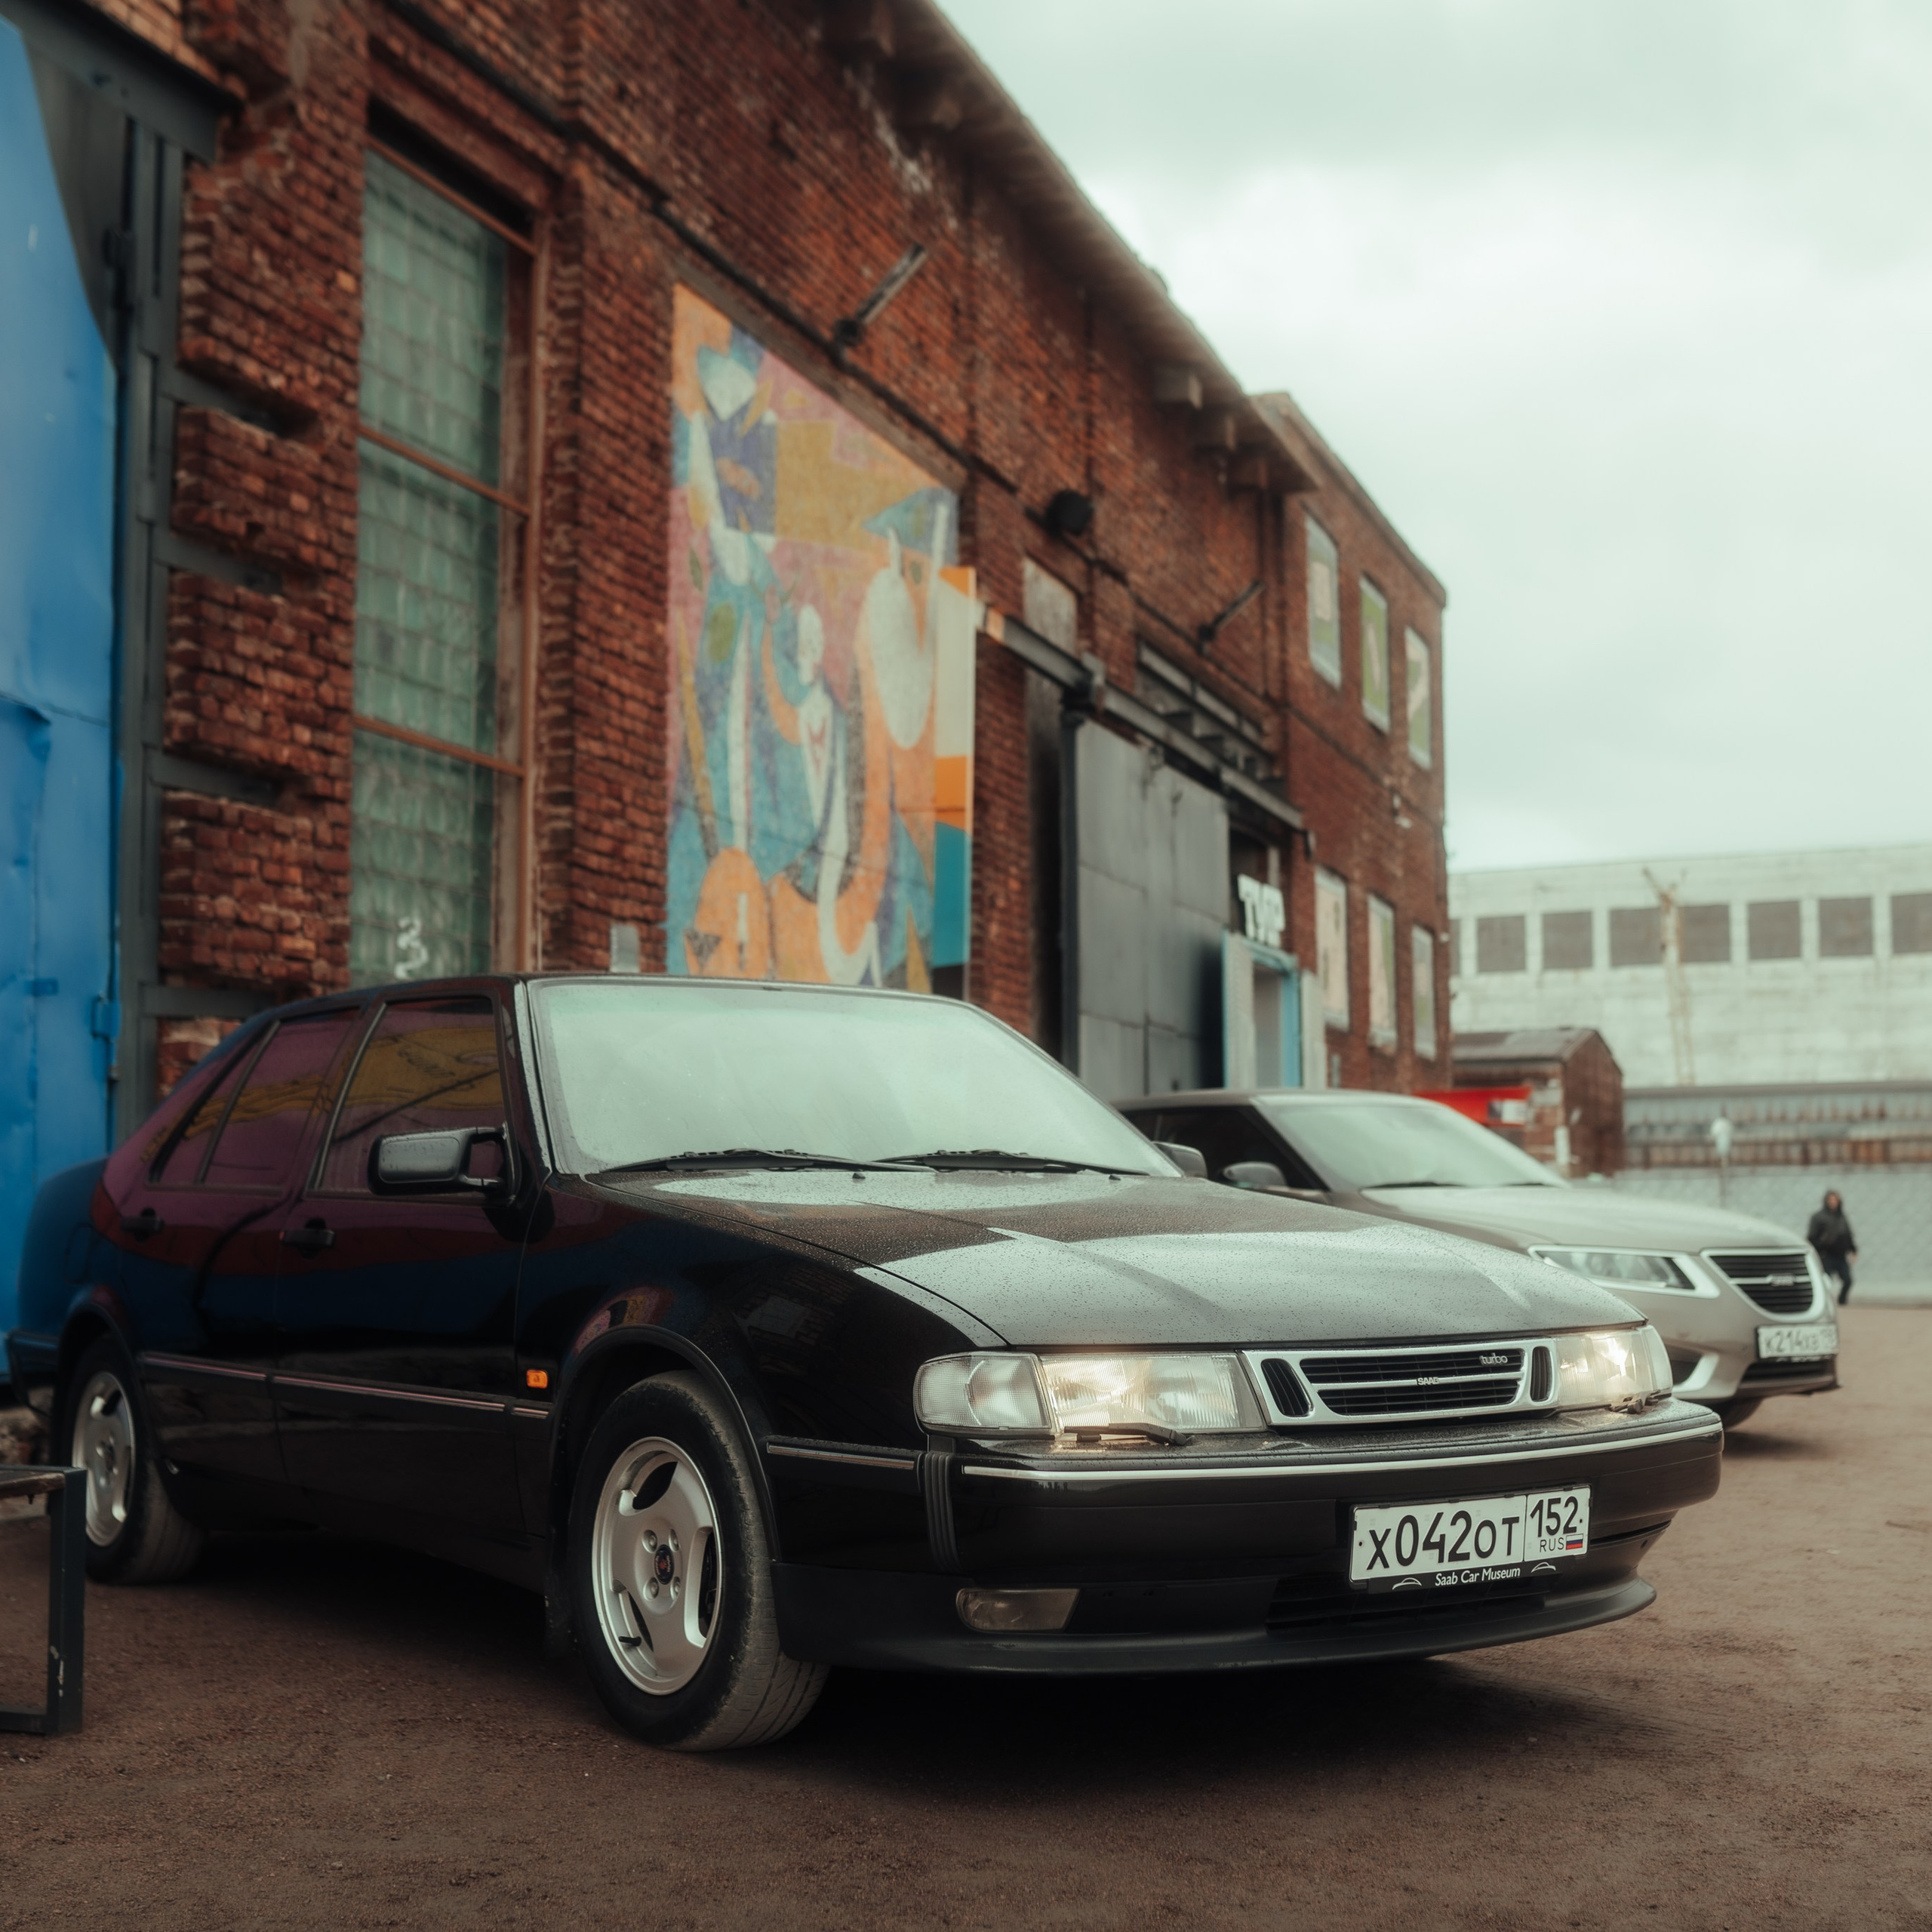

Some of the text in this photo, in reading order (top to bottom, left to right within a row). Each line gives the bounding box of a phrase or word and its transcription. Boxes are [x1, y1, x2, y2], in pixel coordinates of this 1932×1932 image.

[1479, 1352, 1508, 1365] turbo
[1417, 1377, 1439, 1386] SAAB
[1530, 1497, 1578, 1538] 152
[1539, 1537, 1564, 1553] RUS
[1435, 1567, 1521, 1586] Saab Car Museum
